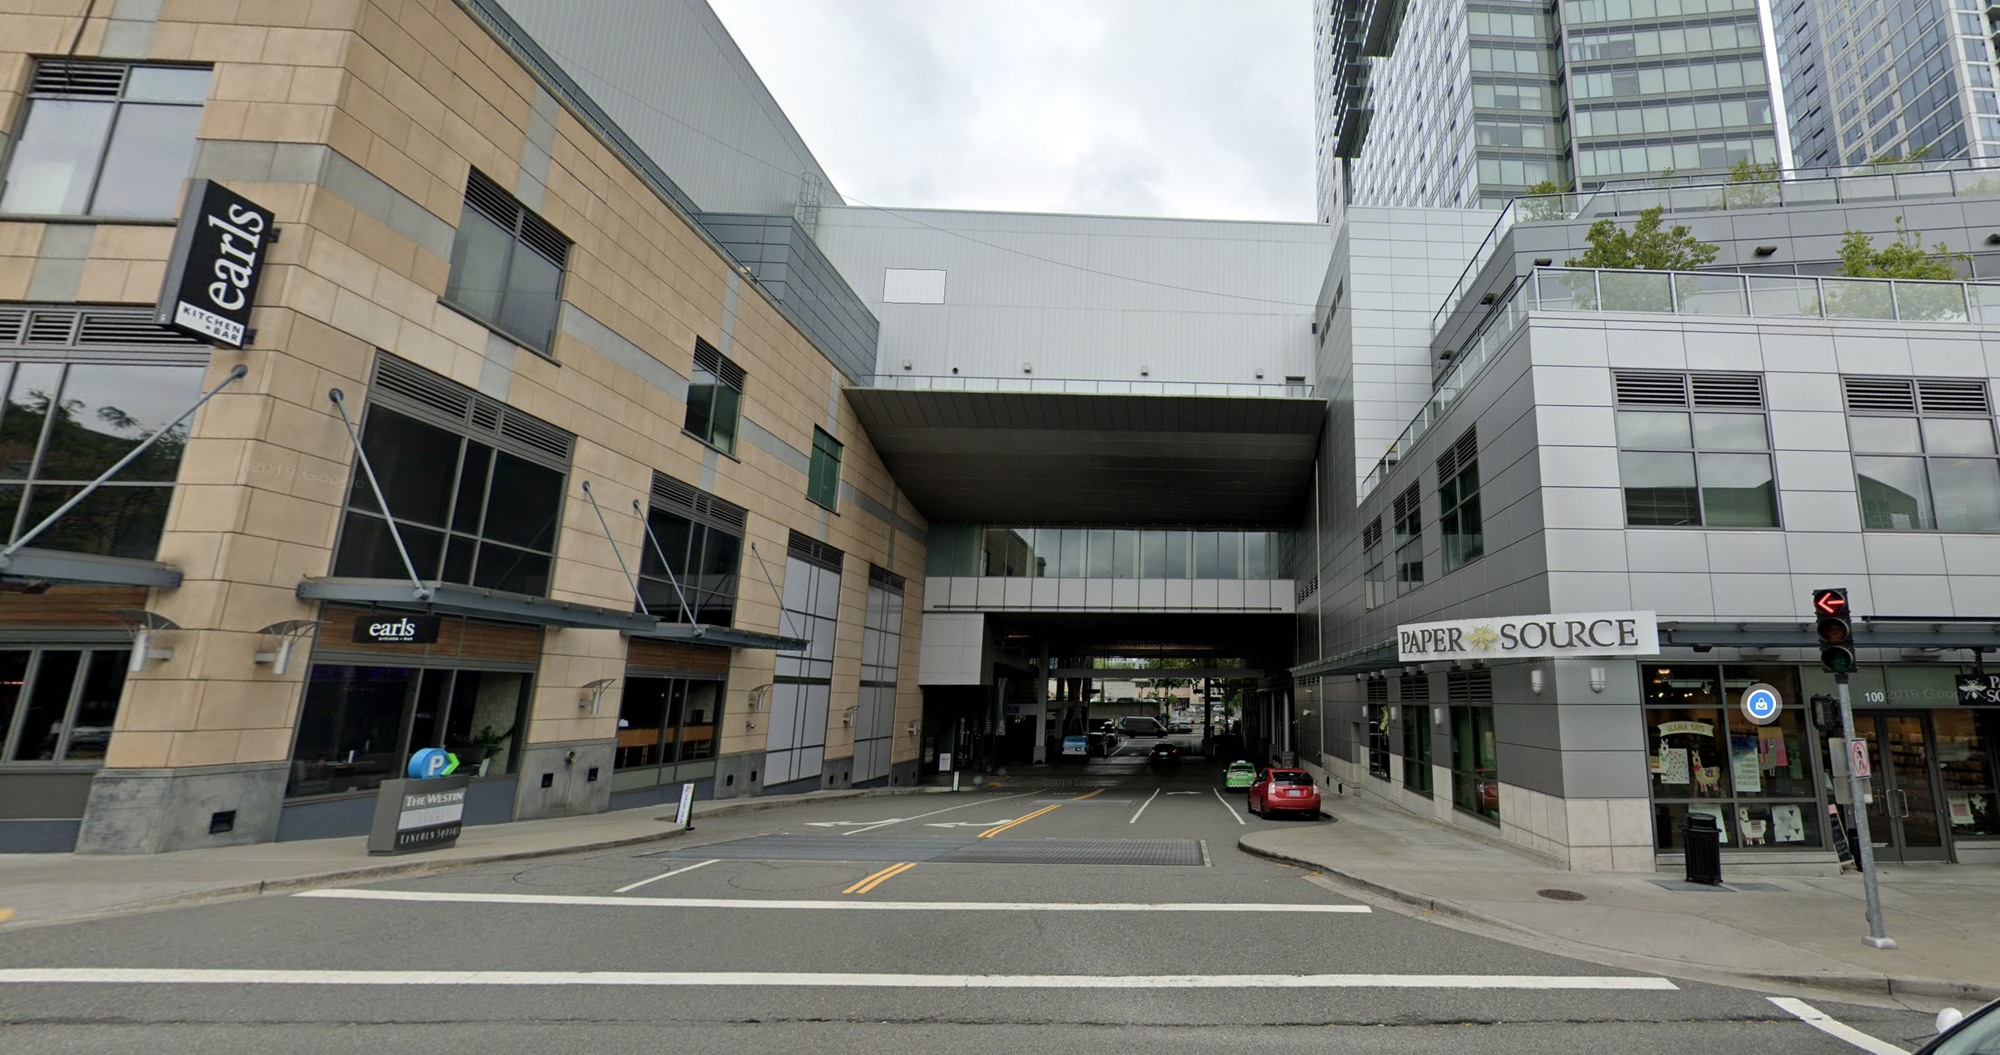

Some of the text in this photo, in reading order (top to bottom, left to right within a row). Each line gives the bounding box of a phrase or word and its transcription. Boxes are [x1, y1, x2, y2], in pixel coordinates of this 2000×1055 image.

[207, 203, 264, 311] earls
[182, 307, 241, 334] KITCHEN
[213, 327, 239, 341] BAR
[368, 617, 415, 636] earls
[1400, 618, 1639, 655] PAPER SOURCE
[1988, 675, 2000, 689] P
[1864, 691, 1885, 703] 100
[1666, 723, 1689, 732] LLAMA
[427, 754, 445, 776] P
[406, 792, 464, 807] THE WESTIN
[400, 831, 435, 845] LINCOLN
